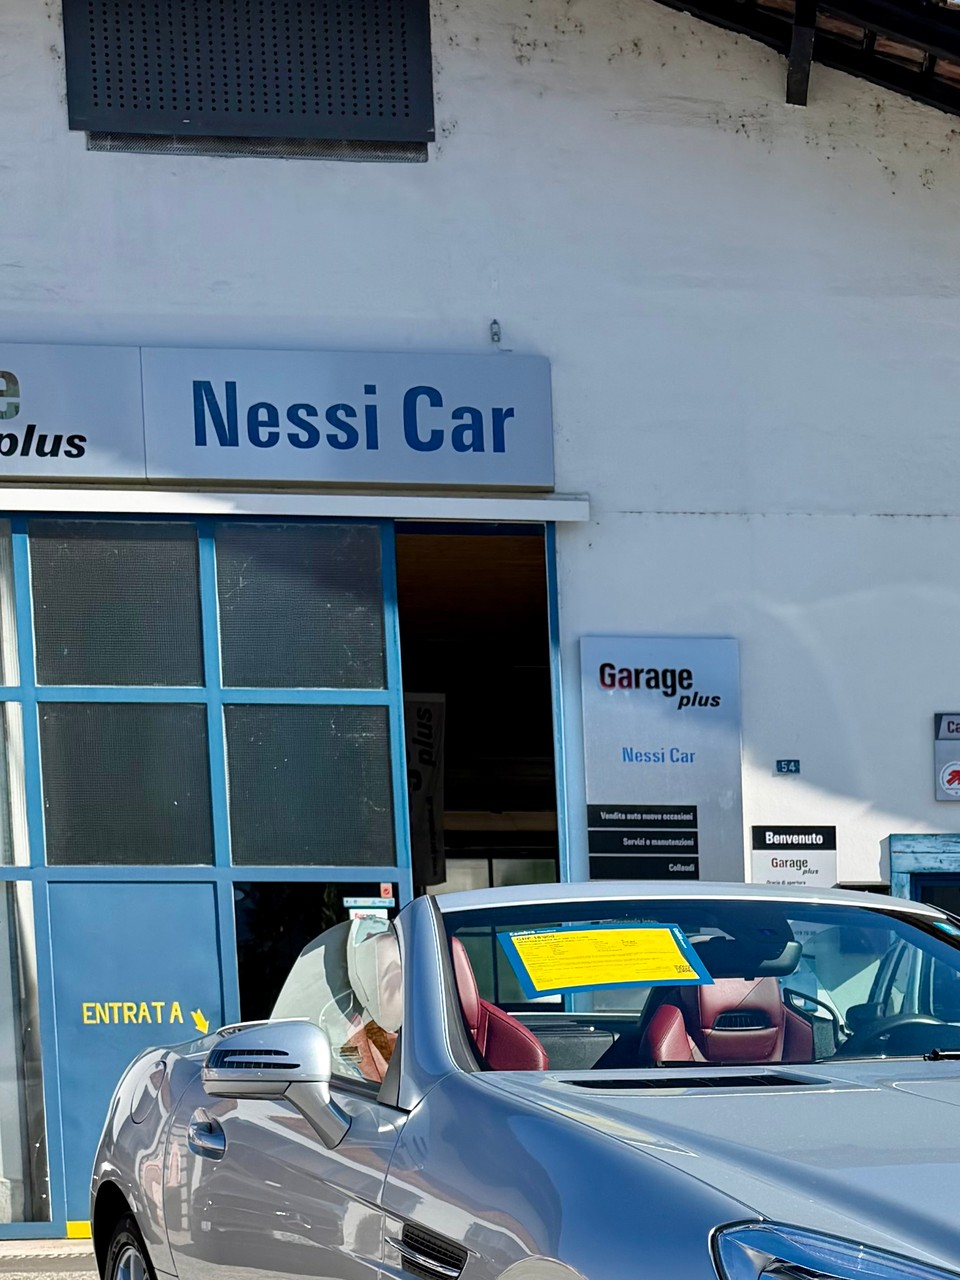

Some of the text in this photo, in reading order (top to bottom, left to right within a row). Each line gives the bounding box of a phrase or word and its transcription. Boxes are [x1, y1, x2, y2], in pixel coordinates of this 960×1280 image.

[192, 380, 515, 453] Nessi Car
[599, 662, 693, 697] Garage
[677, 692, 721, 710] plus
[621, 747, 696, 763] Nessi Car
[780, 761, 797, 773] 54
[600, 811, 626, 820] Vendita
[626, 812, 641, 820] auto
[662, 812, 694, 821] occasioni
[623, 837, 646, 847] Servizi
[651, 837, 695, 847] manutenzioni
[765, 832, 824, 845] Benvenuto
[771, 857, 809, 872] Garage
[802, 868, 819, 876] plus
[82, 1001, 183, 1025] ENTRATA
